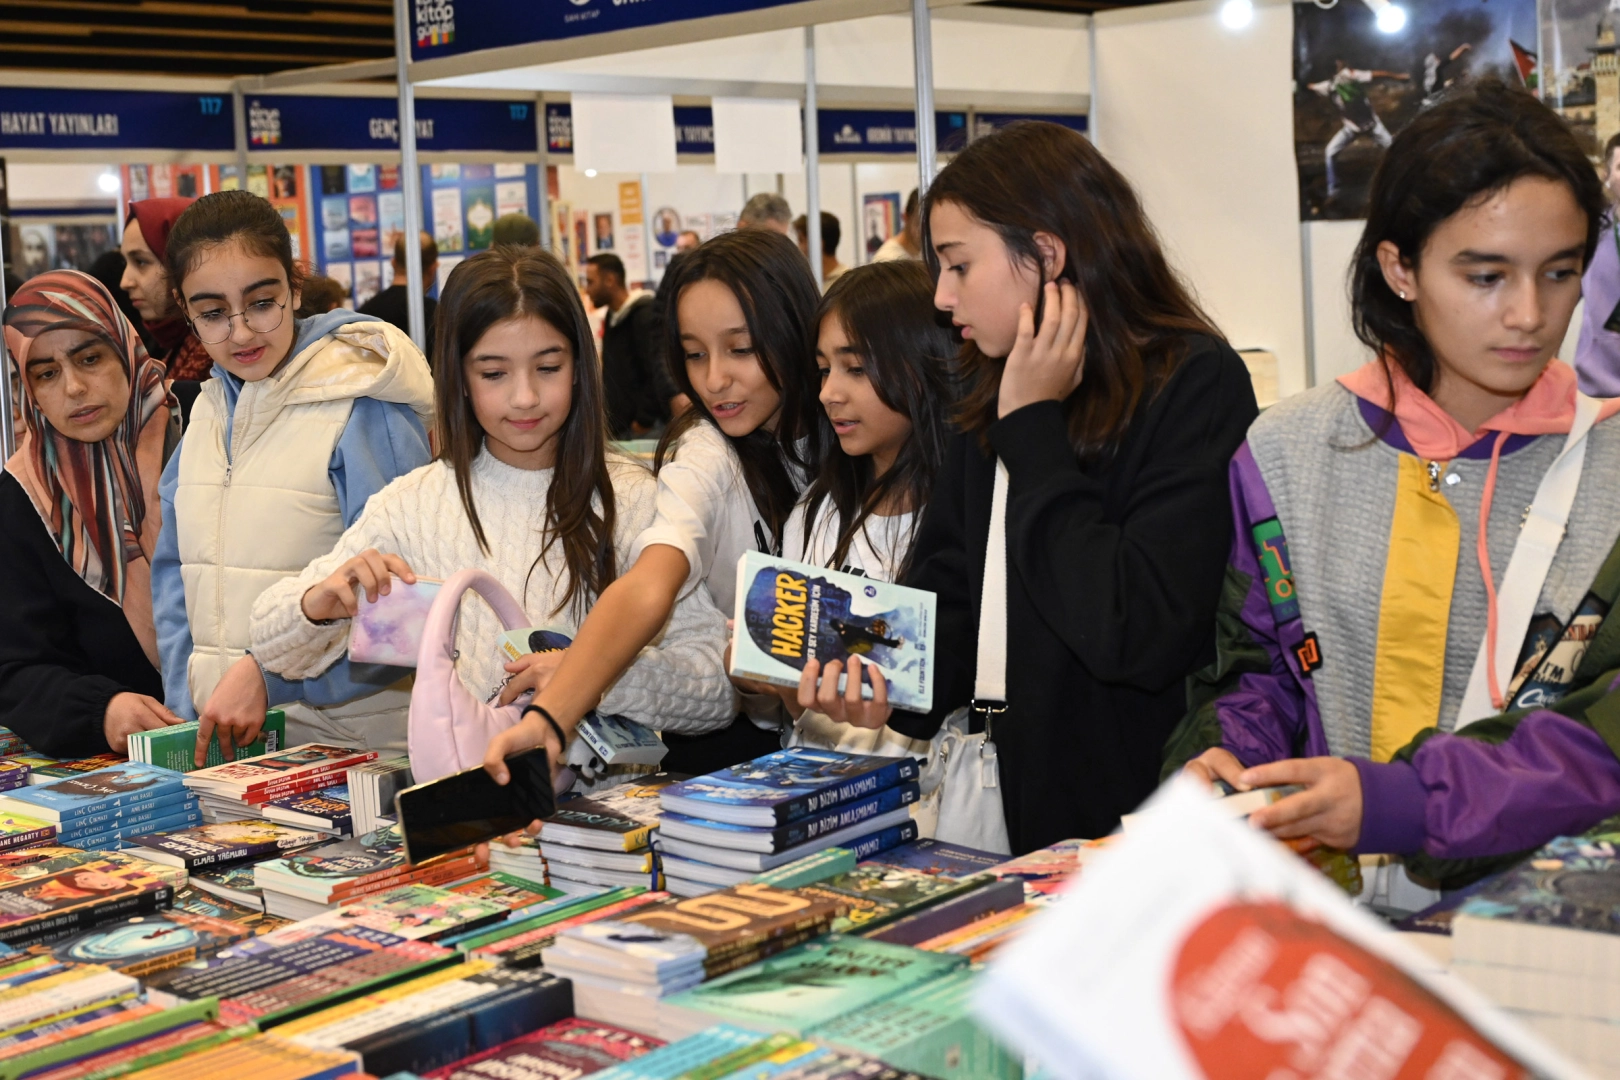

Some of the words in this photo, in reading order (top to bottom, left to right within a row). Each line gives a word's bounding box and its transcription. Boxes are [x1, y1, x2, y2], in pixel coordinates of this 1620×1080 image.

[199, 97, 223, 115] 117
[1, 112, 45, 135] HAYAT
[49, 113, 119, 136] YAYINLARI
[369, 118, 397, 142] GENÇ
[771, 572, 808, 658] HACKER
[807, 798, 819, 813] BU
[819, 790, 839, 808] BİZİM
[839, 776, 877, 798] ANLAŞMAMIZ
[807, 824, 818, 838] BU
[819, 815, 839, 834] BİZİM
[840, 801, 878, 825] ANLAŞMAMIZ
[13, 831, 40, 843] HEGARTY
[193, 854, 215, 866] ELMAS
[218, 848, 248, 861] YAĞMURU
